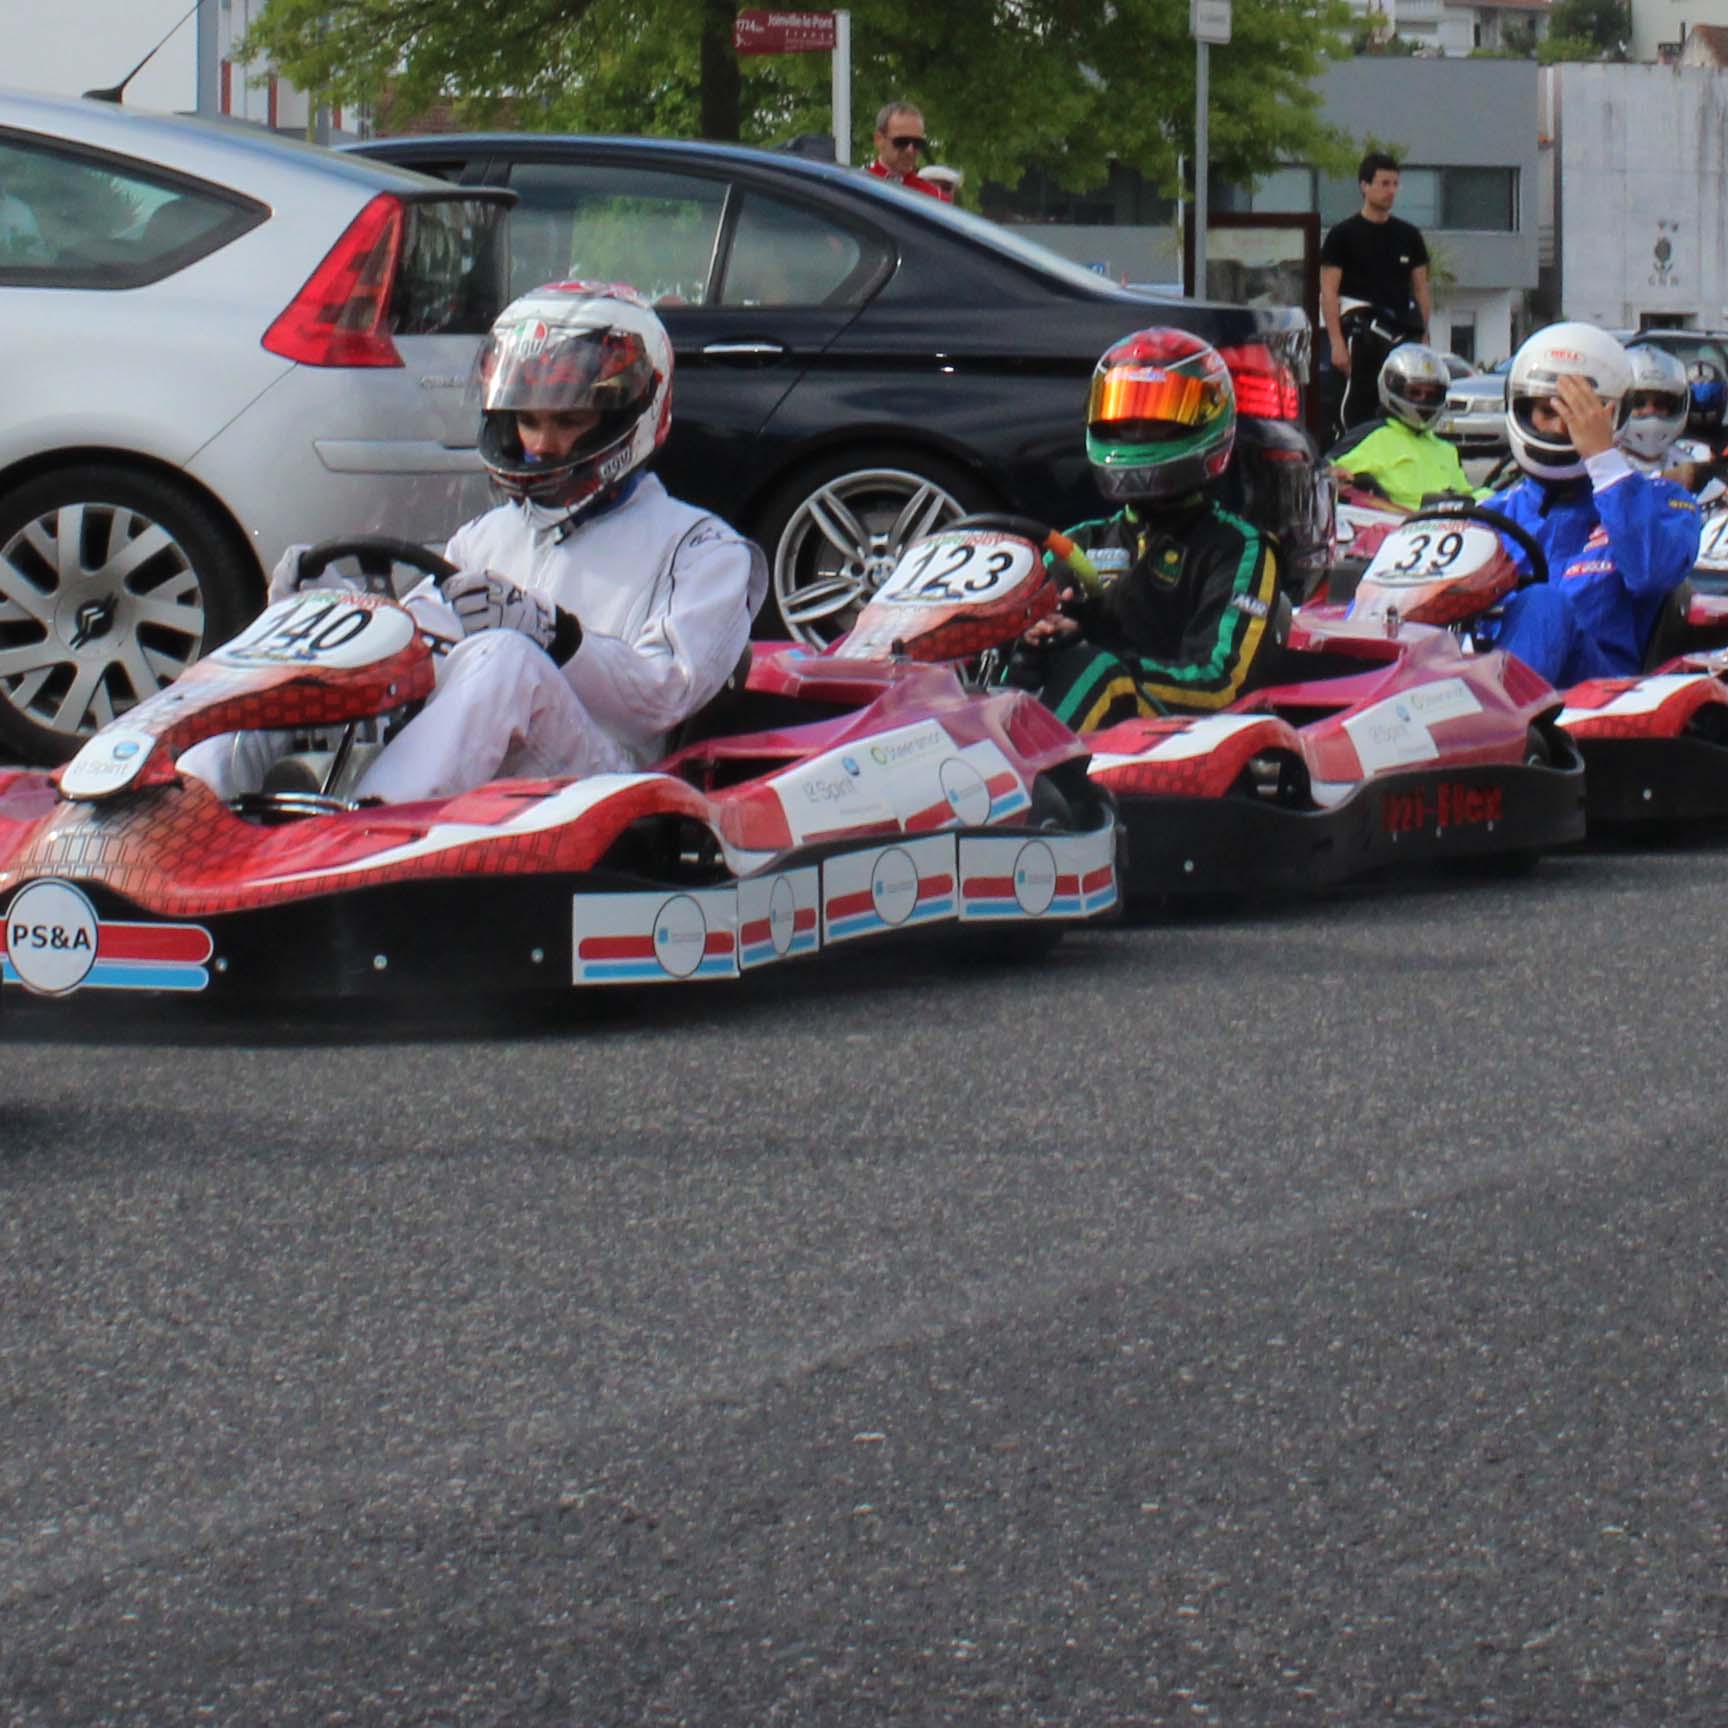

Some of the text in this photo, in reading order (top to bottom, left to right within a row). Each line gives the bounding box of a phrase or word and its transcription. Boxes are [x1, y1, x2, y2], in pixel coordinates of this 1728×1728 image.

[901, 543, 1014, 593] 123
[1393, 532, 1465, 571] 39
[246, 601, 374, 652] 140
[12, 924, 91, 951] PS&A
